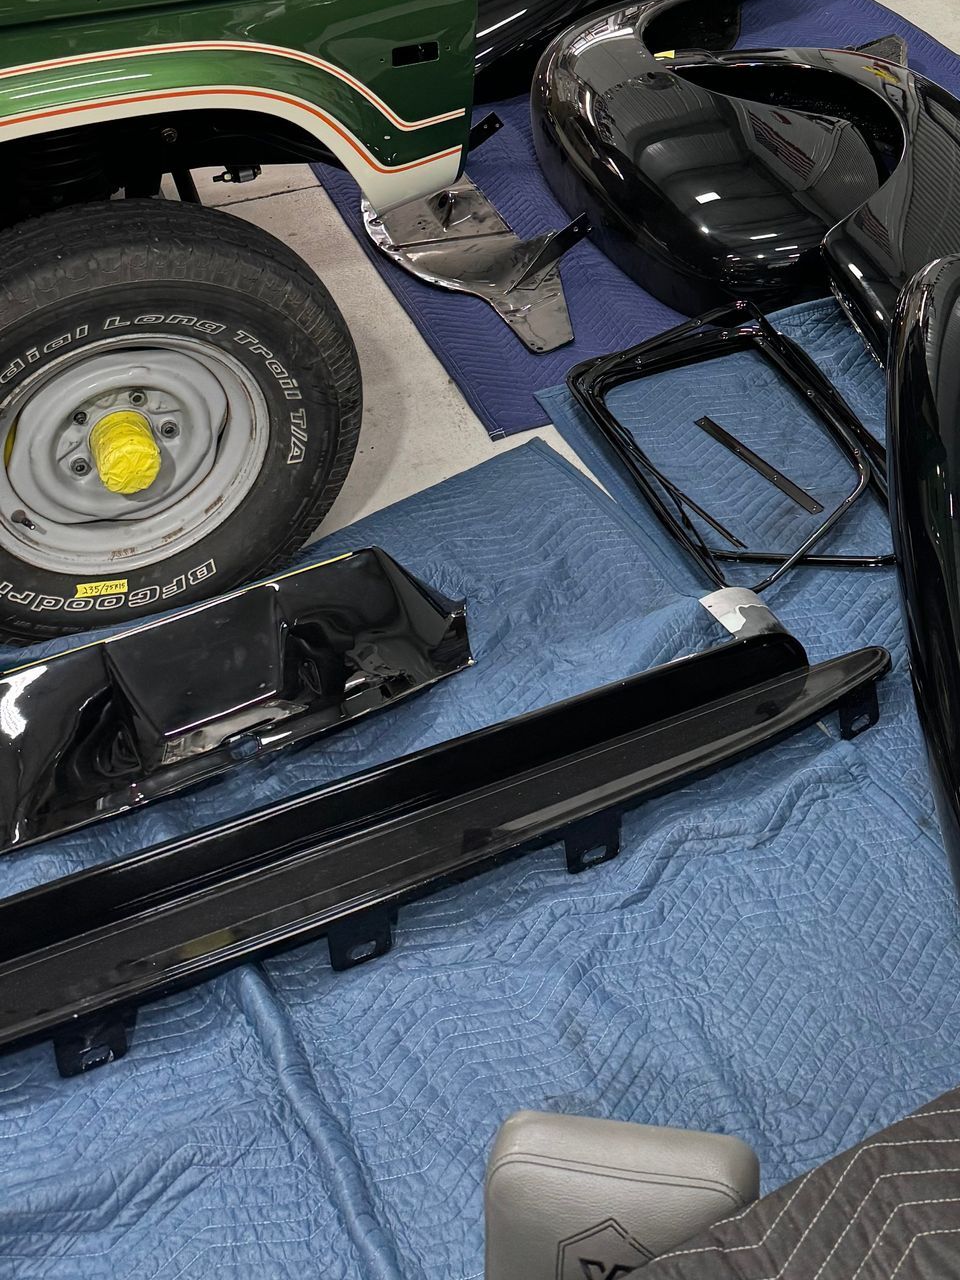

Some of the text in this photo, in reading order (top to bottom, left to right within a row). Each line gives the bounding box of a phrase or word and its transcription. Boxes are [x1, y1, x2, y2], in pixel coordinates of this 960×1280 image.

[0, 314, 308, 465] dial Long Trail T/A
[0, 558, 217, 612] BFGoodri
[81, 582, 126, 596] 235/75R15
